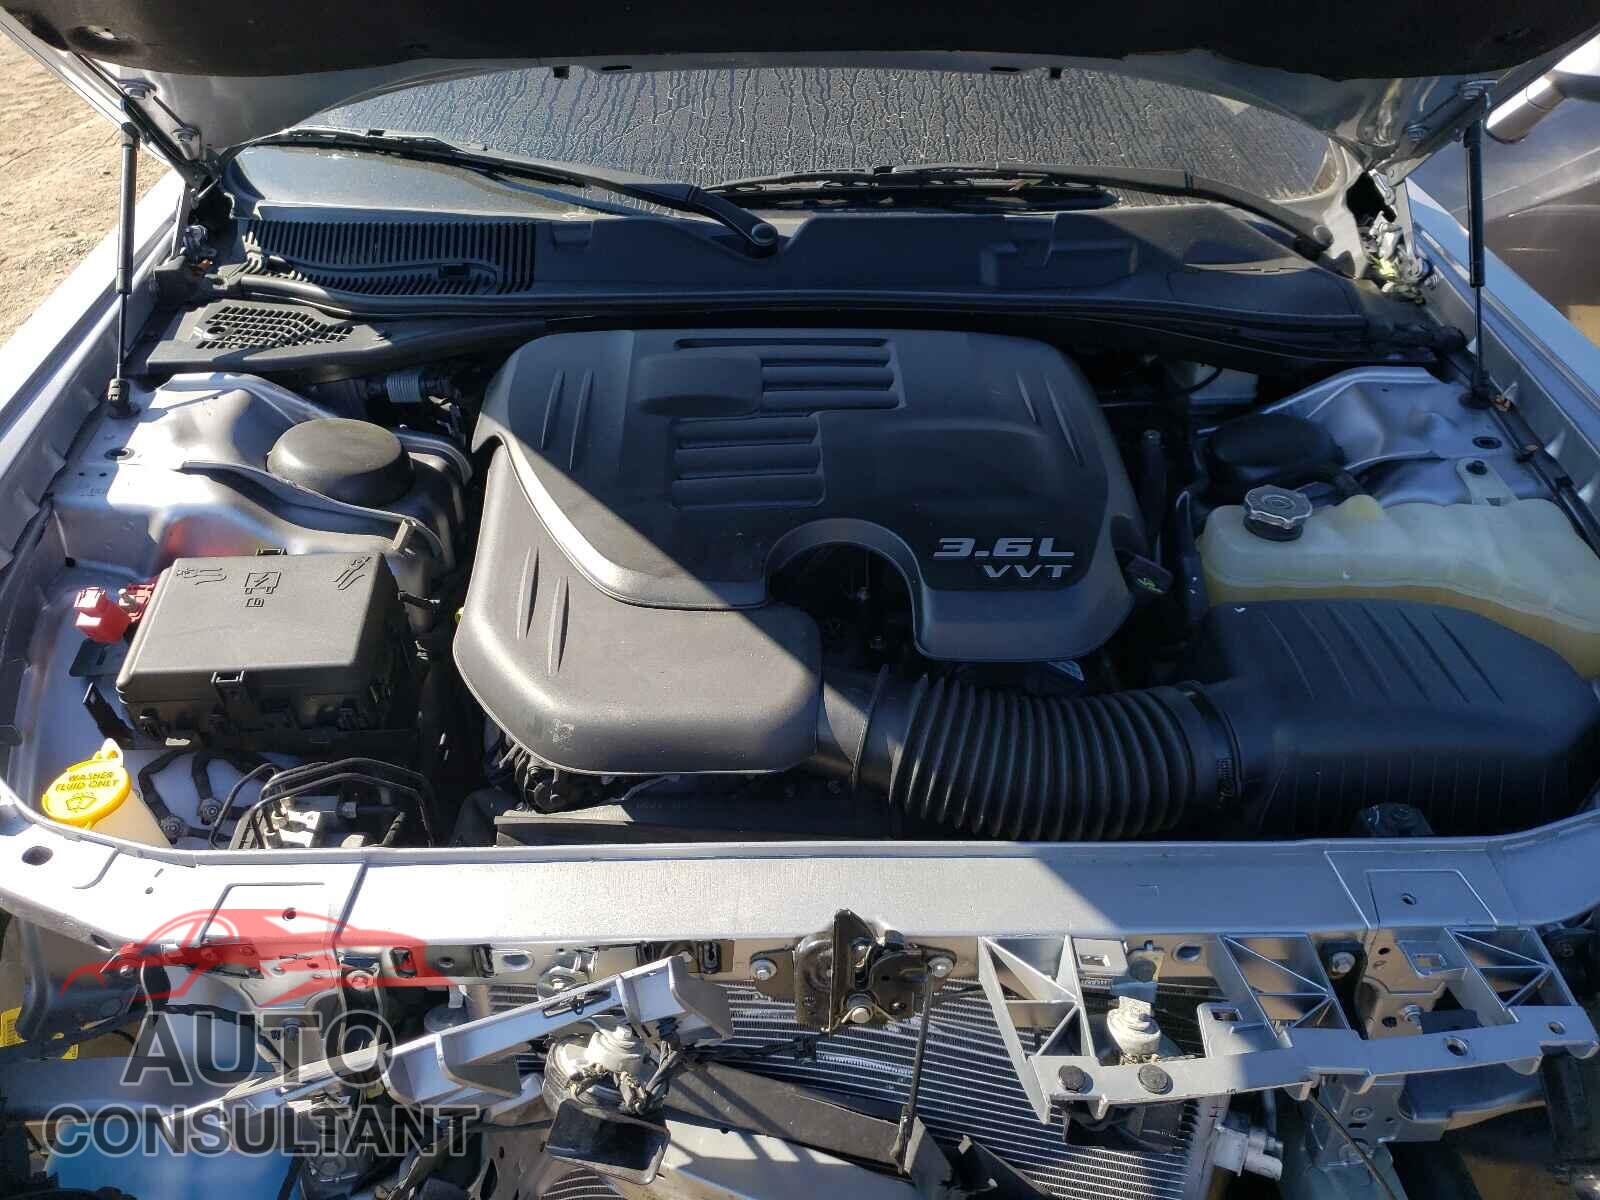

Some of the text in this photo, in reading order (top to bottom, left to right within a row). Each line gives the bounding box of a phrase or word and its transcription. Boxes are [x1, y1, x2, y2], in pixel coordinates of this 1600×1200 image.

[933, 537, 1075, 558] 3.6L
[982, 564, 1073, 578] VVT
[68, 771, 115, 782] WASHER
[55, 779, 120, 792] FLUID ONLY
